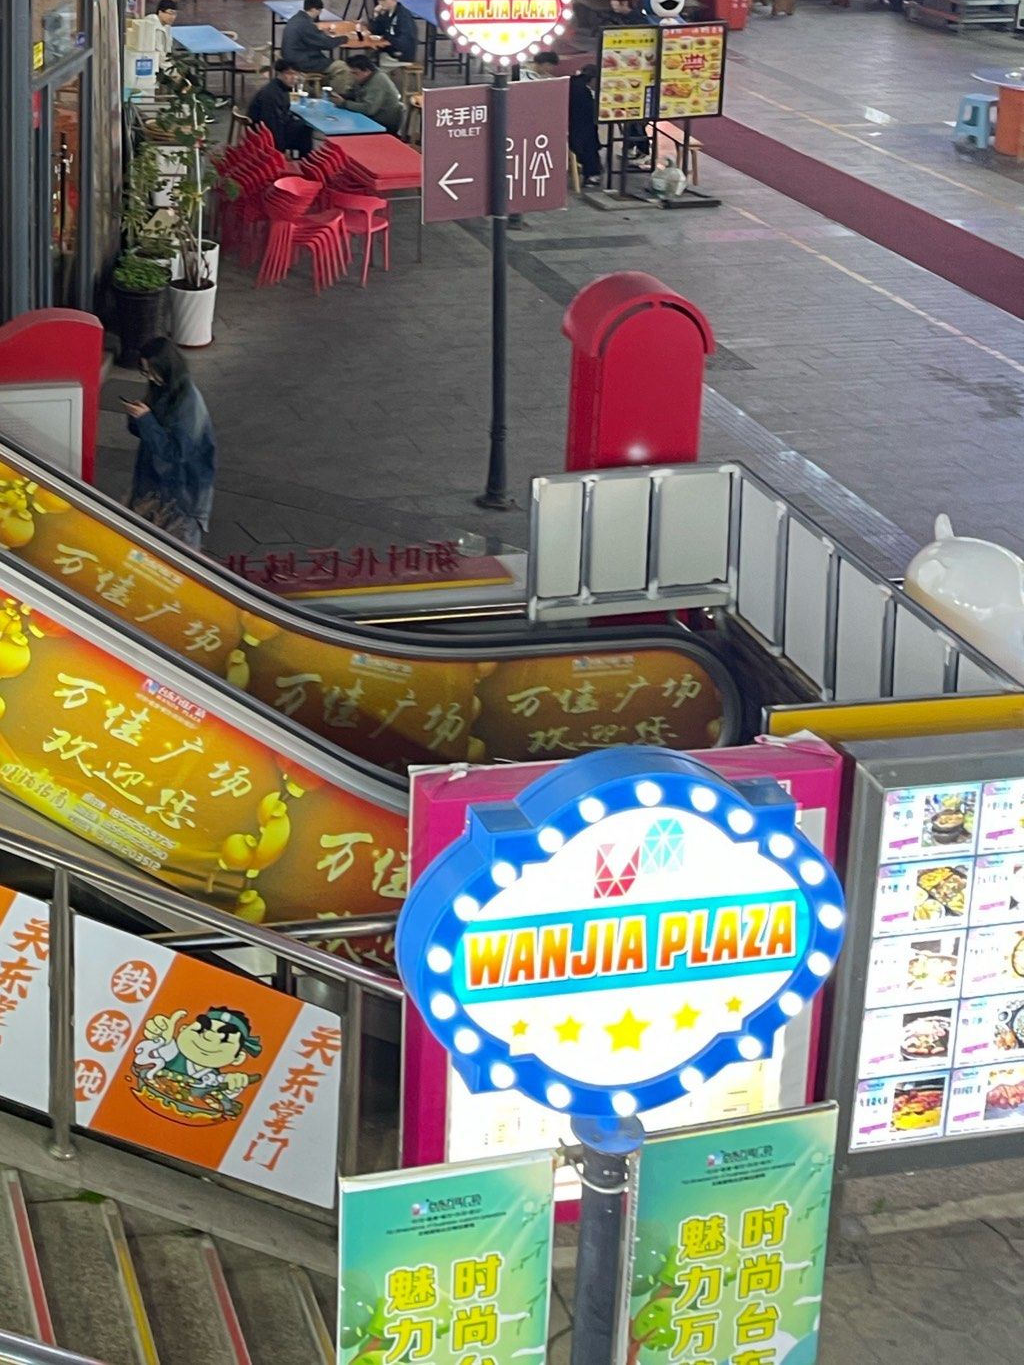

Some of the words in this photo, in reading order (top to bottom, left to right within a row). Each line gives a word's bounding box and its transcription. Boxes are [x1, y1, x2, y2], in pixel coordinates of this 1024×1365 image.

[436, 105, 488, 128] 洗手间
[447, 126, 481, 138] TOILET
[53, 543, 225, 653] 万佳广场
[54, 671, 253, 799] 万佳广场
[466, 912, 648, 989] WANJIA
[658, 900, 796, 971] PLAZA
[75, 961, 154, 1099] 铁锅炖
[241, 1024, 342, 1173] 关东掌门
[674, 1215, 728, 1365] 魅力万
